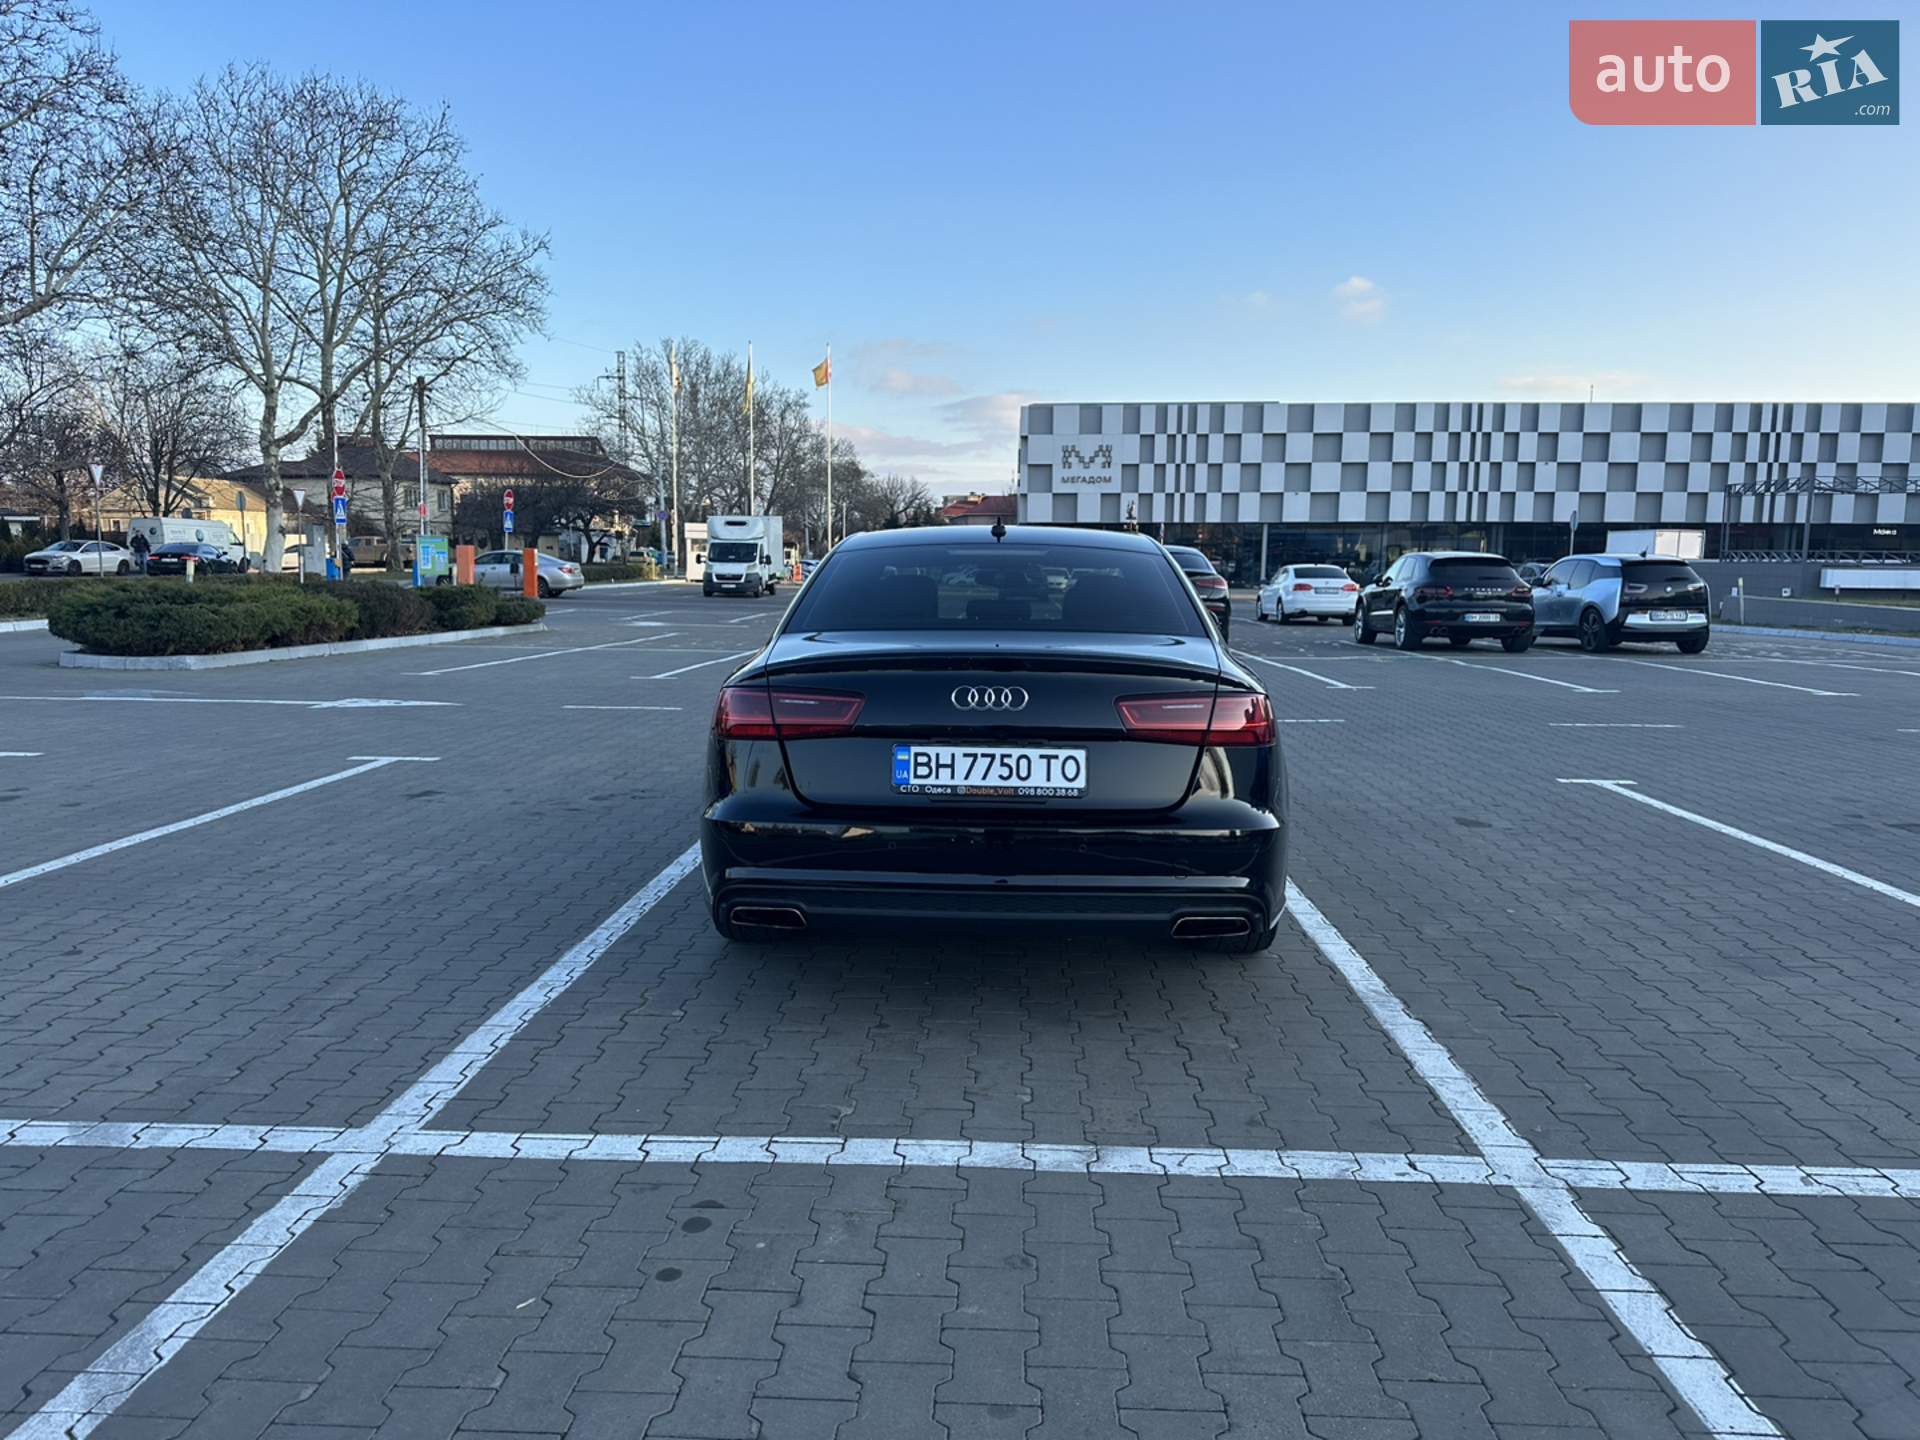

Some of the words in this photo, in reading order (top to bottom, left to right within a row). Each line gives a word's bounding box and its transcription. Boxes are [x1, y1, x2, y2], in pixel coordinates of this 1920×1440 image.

[1061, 476, 1112, 484] МЕГАДОМ
[913, 752, 956, 780] BH
[962, 753, 1032, 782] 7750
[1038, 754, 1081, 783] TO
[895, 770, 909, 779] UA
[925, 786, 952, 794] Одеса
